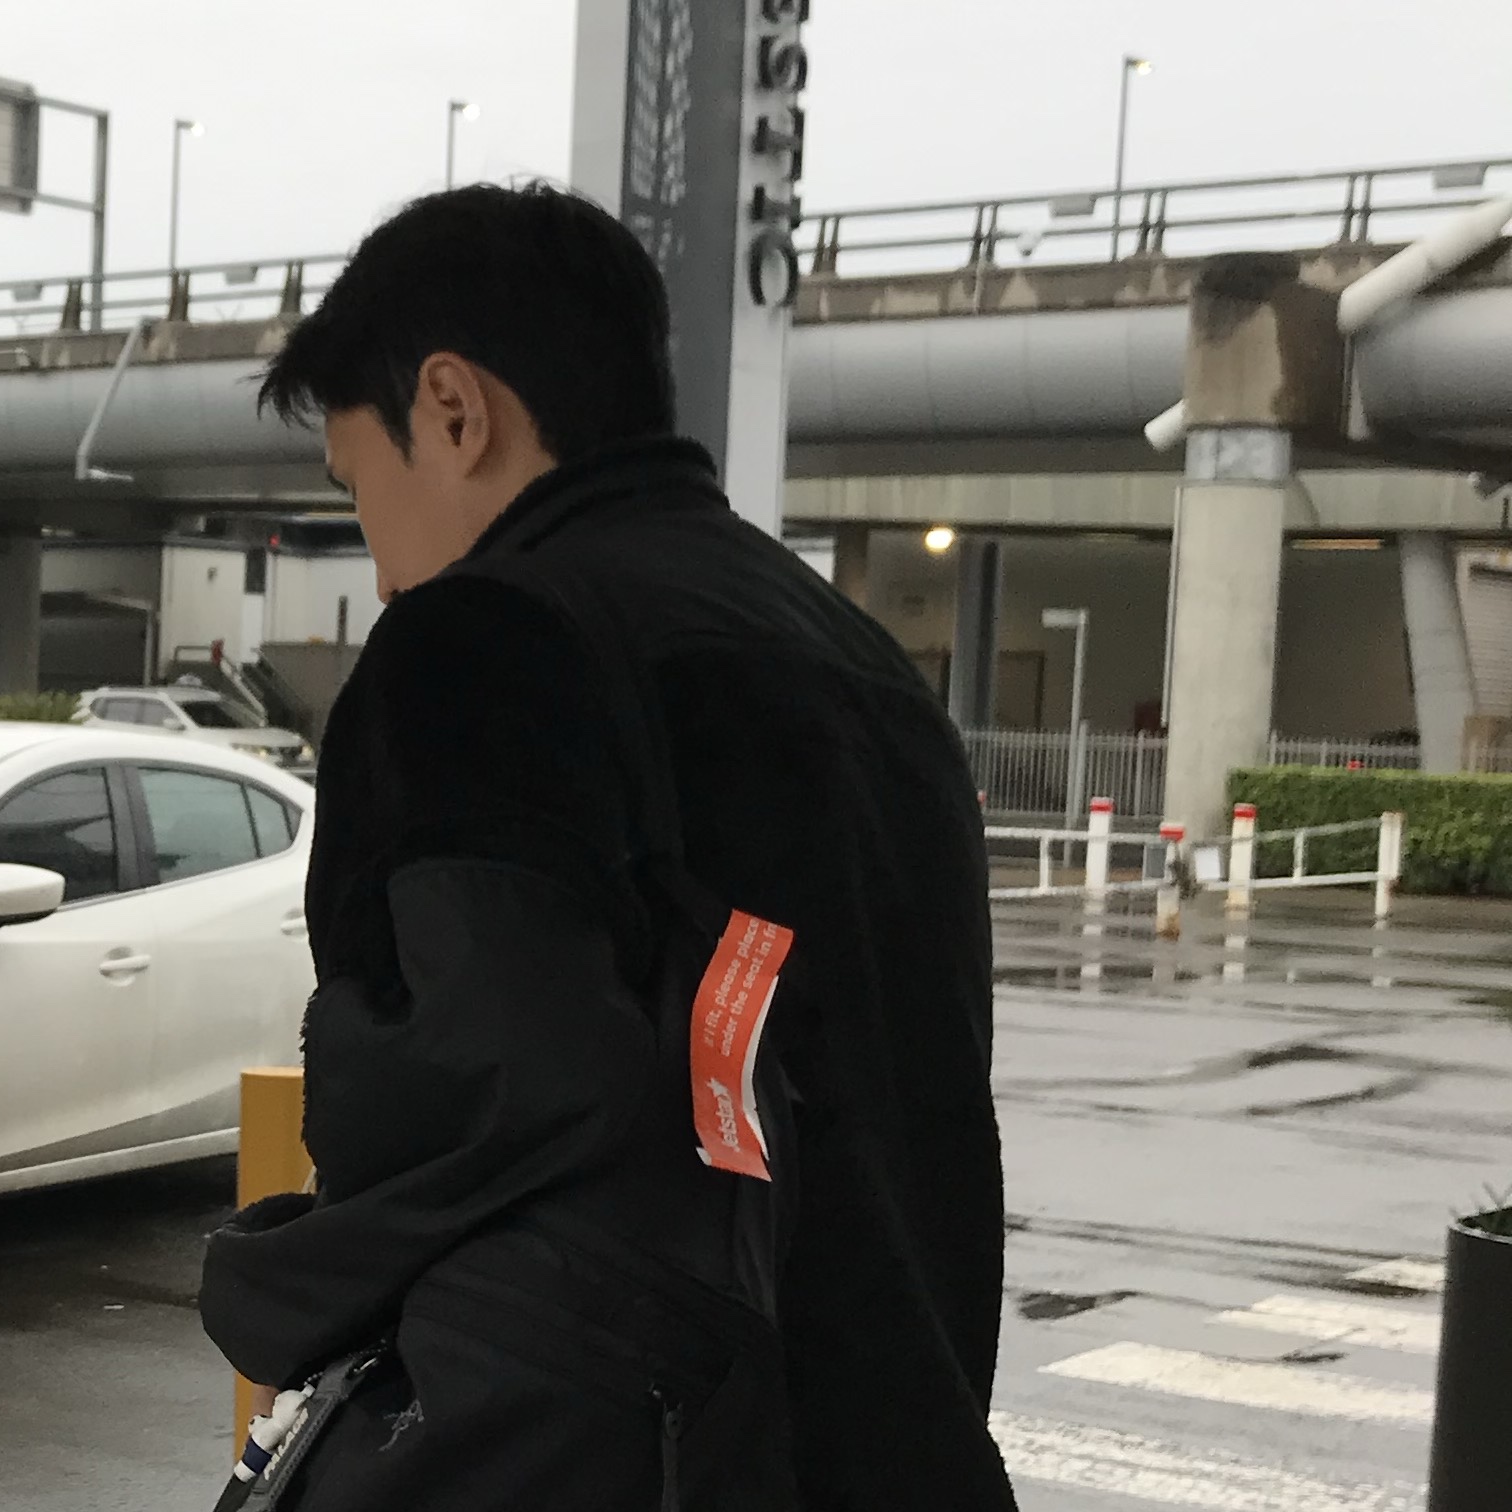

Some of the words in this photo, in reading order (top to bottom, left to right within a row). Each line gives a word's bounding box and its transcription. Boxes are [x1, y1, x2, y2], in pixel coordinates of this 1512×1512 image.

[715, 959, 741, 1008] please
[737, 918, 760, 960] place
[720, 1015, 738, 1058] under
[730, 990, 748, 1016] the
[742, 957, 764, 990] seat
[755, 940, 773, 958] in
